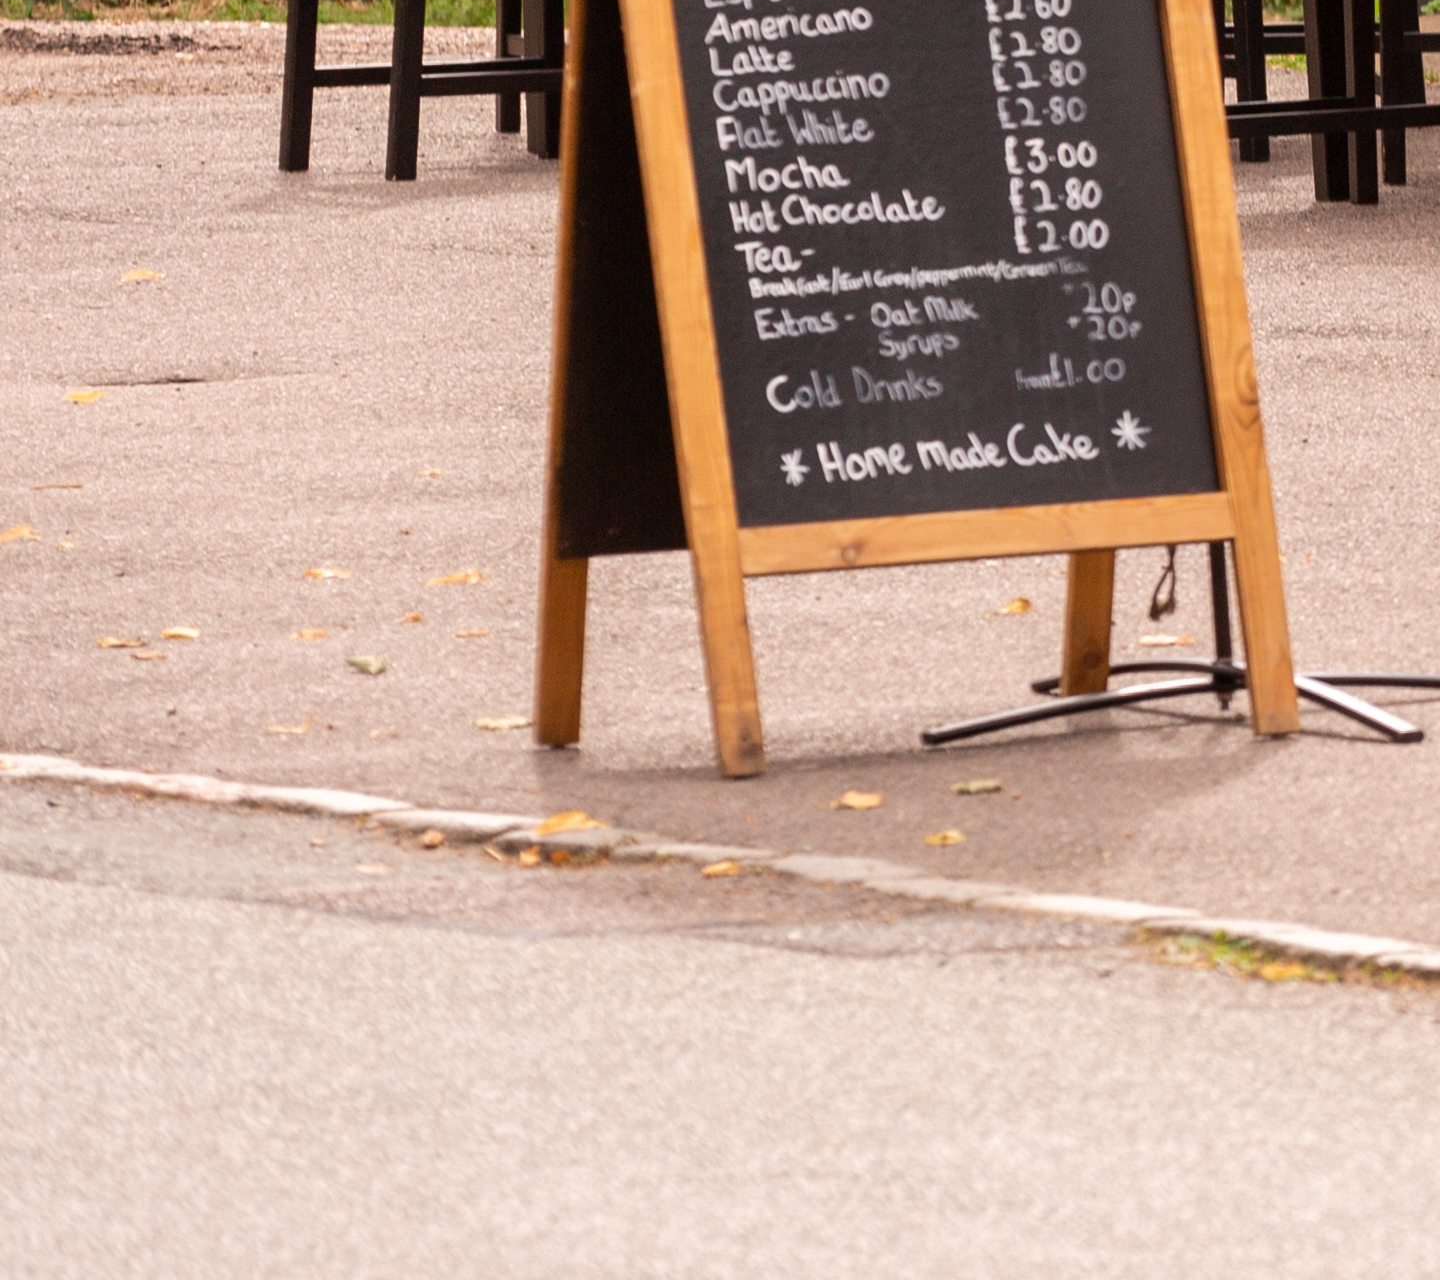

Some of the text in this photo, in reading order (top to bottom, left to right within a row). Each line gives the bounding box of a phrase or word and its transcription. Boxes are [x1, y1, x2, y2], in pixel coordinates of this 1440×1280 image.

[704, 6, 873, 44] Americano
[708, 45, 796, 77] Latte
[712, 69, 891, 116] Cappuccino
[716, 115, 784, 151] Flat
[786, 108, 876, 146] White
[724, 134, 1098, 194] Mocha £3.00
[728, 198, 782, 234] Hot
[780, 188, 946, 226] Chocolate
[754, 306, 839, 340] Extras
[870, 299, 923, 328] Oat
[923, 295, 981, 322] Milk
[878, 329, 960, 361] Syrups
[766, 369, 843, 413] Cold
[851, 366, 944, 404] Drinks
[816, 441, 913, 483] Home
[1006, 422, 1100, 467] Cake
